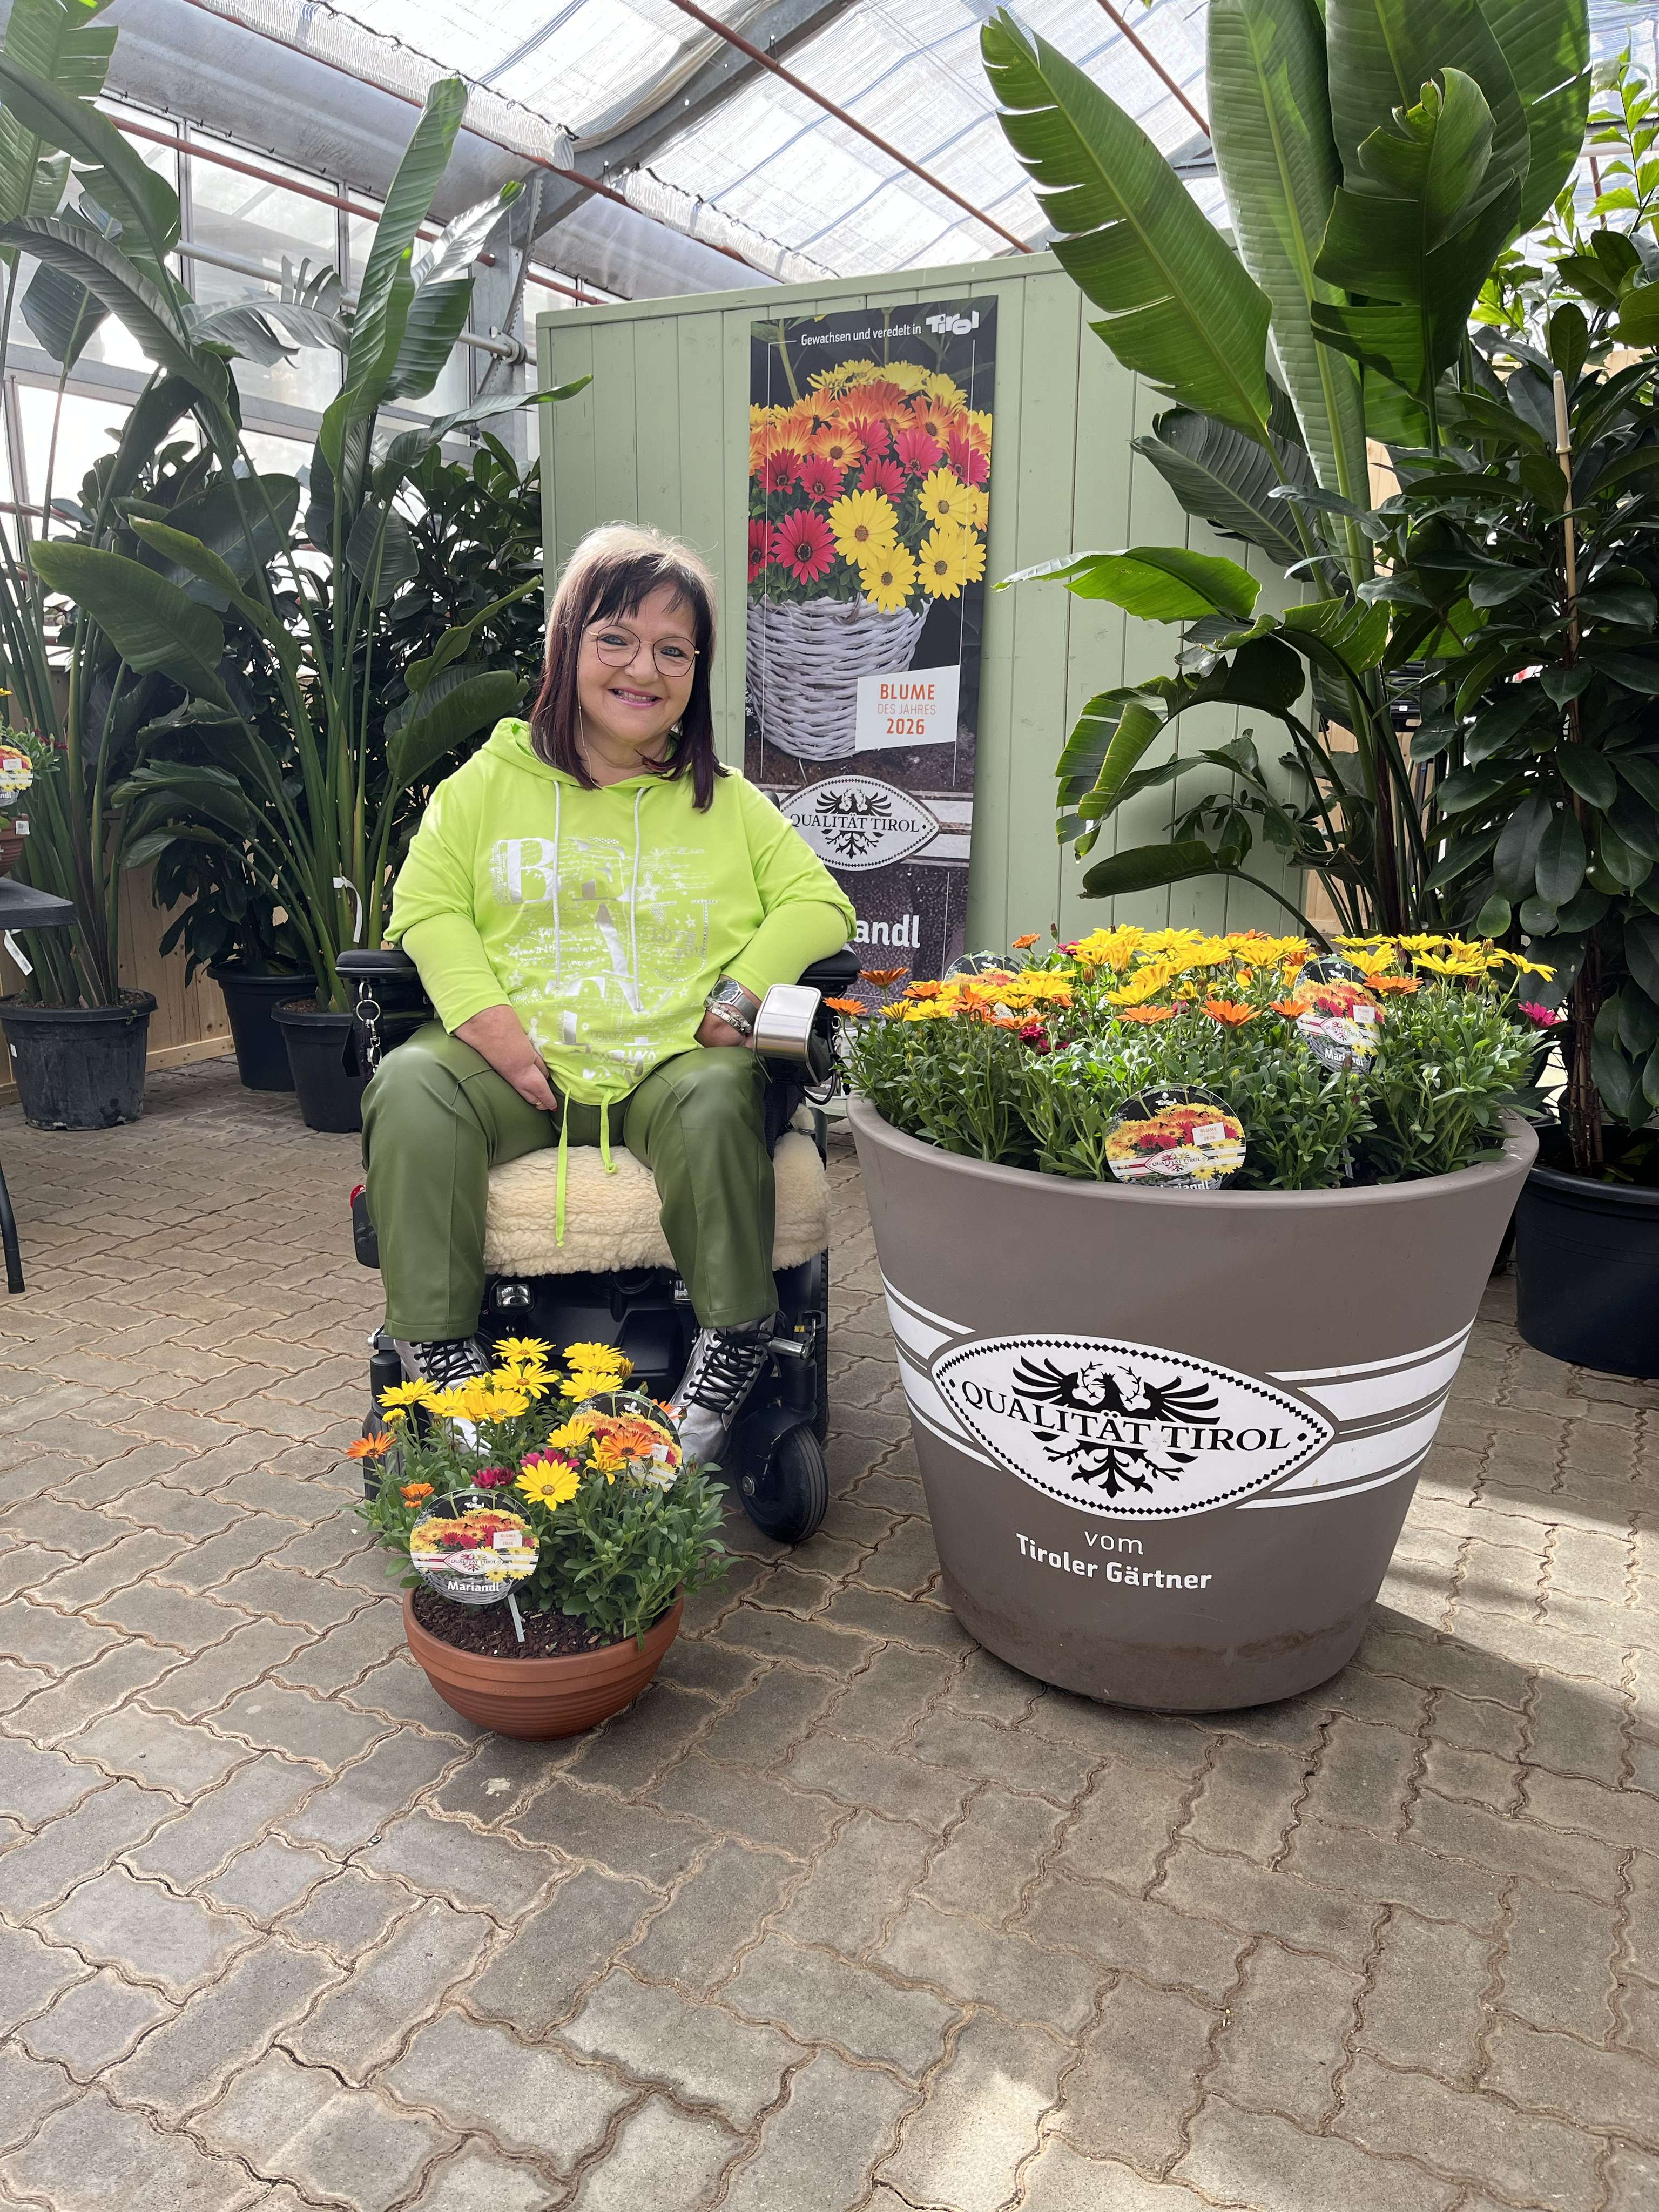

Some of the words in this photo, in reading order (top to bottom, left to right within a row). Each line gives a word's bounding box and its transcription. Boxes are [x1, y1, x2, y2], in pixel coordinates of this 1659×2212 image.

[801, 331, 851, 346] Gewachsen
[853, 328, 871, 340] und
[873, 324, 911, 339] veredelt
[912, 323, 921, 335] in
[926, 311, 979, 335] Tirol
[880, 683, 935, 700] BLUME
[878, 704, 895, 714] DES
[899, 704, 936, 716] JAHRES
[886, 718, 925, 735] 2026
[790, 812, 868, 829] QUALITÄT
[871, 817, 920, 832] TIROL
[854, 914, 920, 948] andl
[1325, 1048, 1364, 1067] Marindl
[961, 1380, 1151, 1445] QUALITÄT
[1161, 1425, 1291, 1451] TIROL
[1084, 1531, 1144, 1555] vom
[1016, 1532, 1098, 1577] Tiroler
[1106, 1562, 1212, 1589] Gärtner
[447, 1581, 500, 1593] Mariandl
